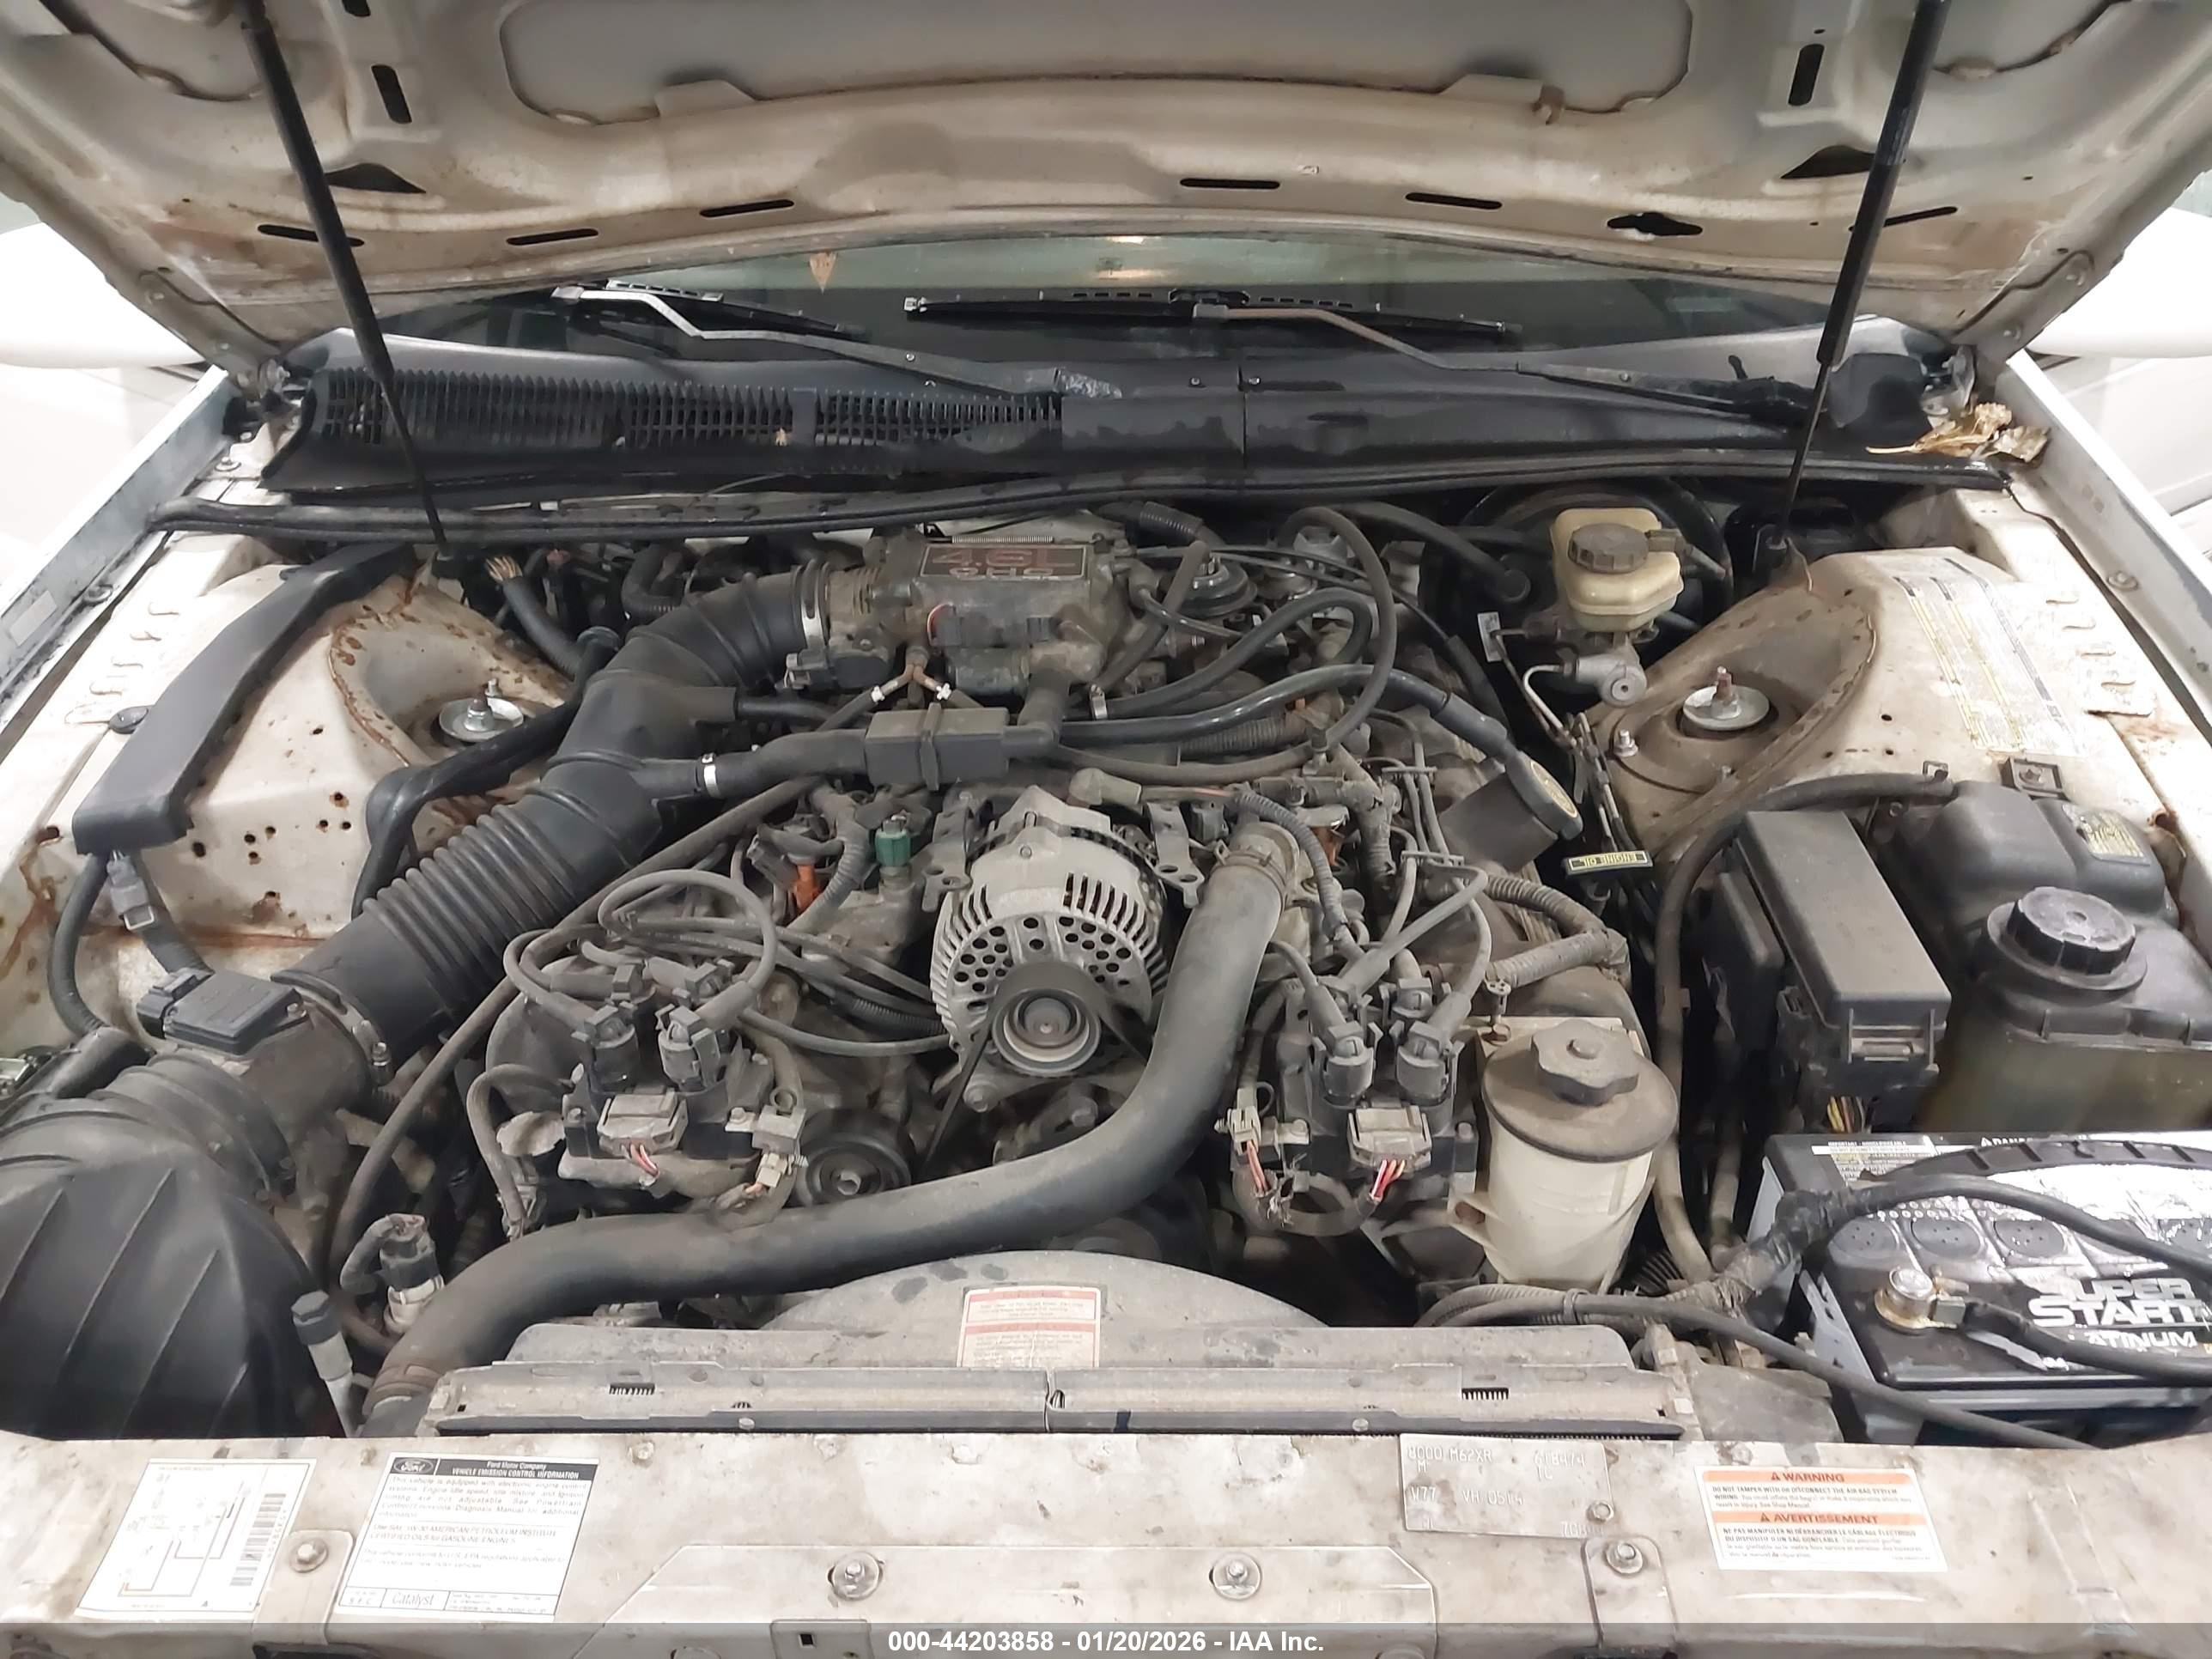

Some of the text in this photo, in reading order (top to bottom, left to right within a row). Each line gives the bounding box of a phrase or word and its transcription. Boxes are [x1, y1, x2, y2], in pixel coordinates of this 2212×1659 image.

[933, 549, 1075, 567] 4.6L
[2027, 1296, 2203, 1328] START
[487, 1460, 547, 1472] Ford Motor Company
[453, 1467, 580, 1480] VEHICLE EMISSION CONTROL INFORMATION
[1782, 1472, 1845, 1483] WARNING
[1773, 1512, 1879, 1525] AVERTISSEMENT
[392, 1592, 434, 1607] Catalyst
